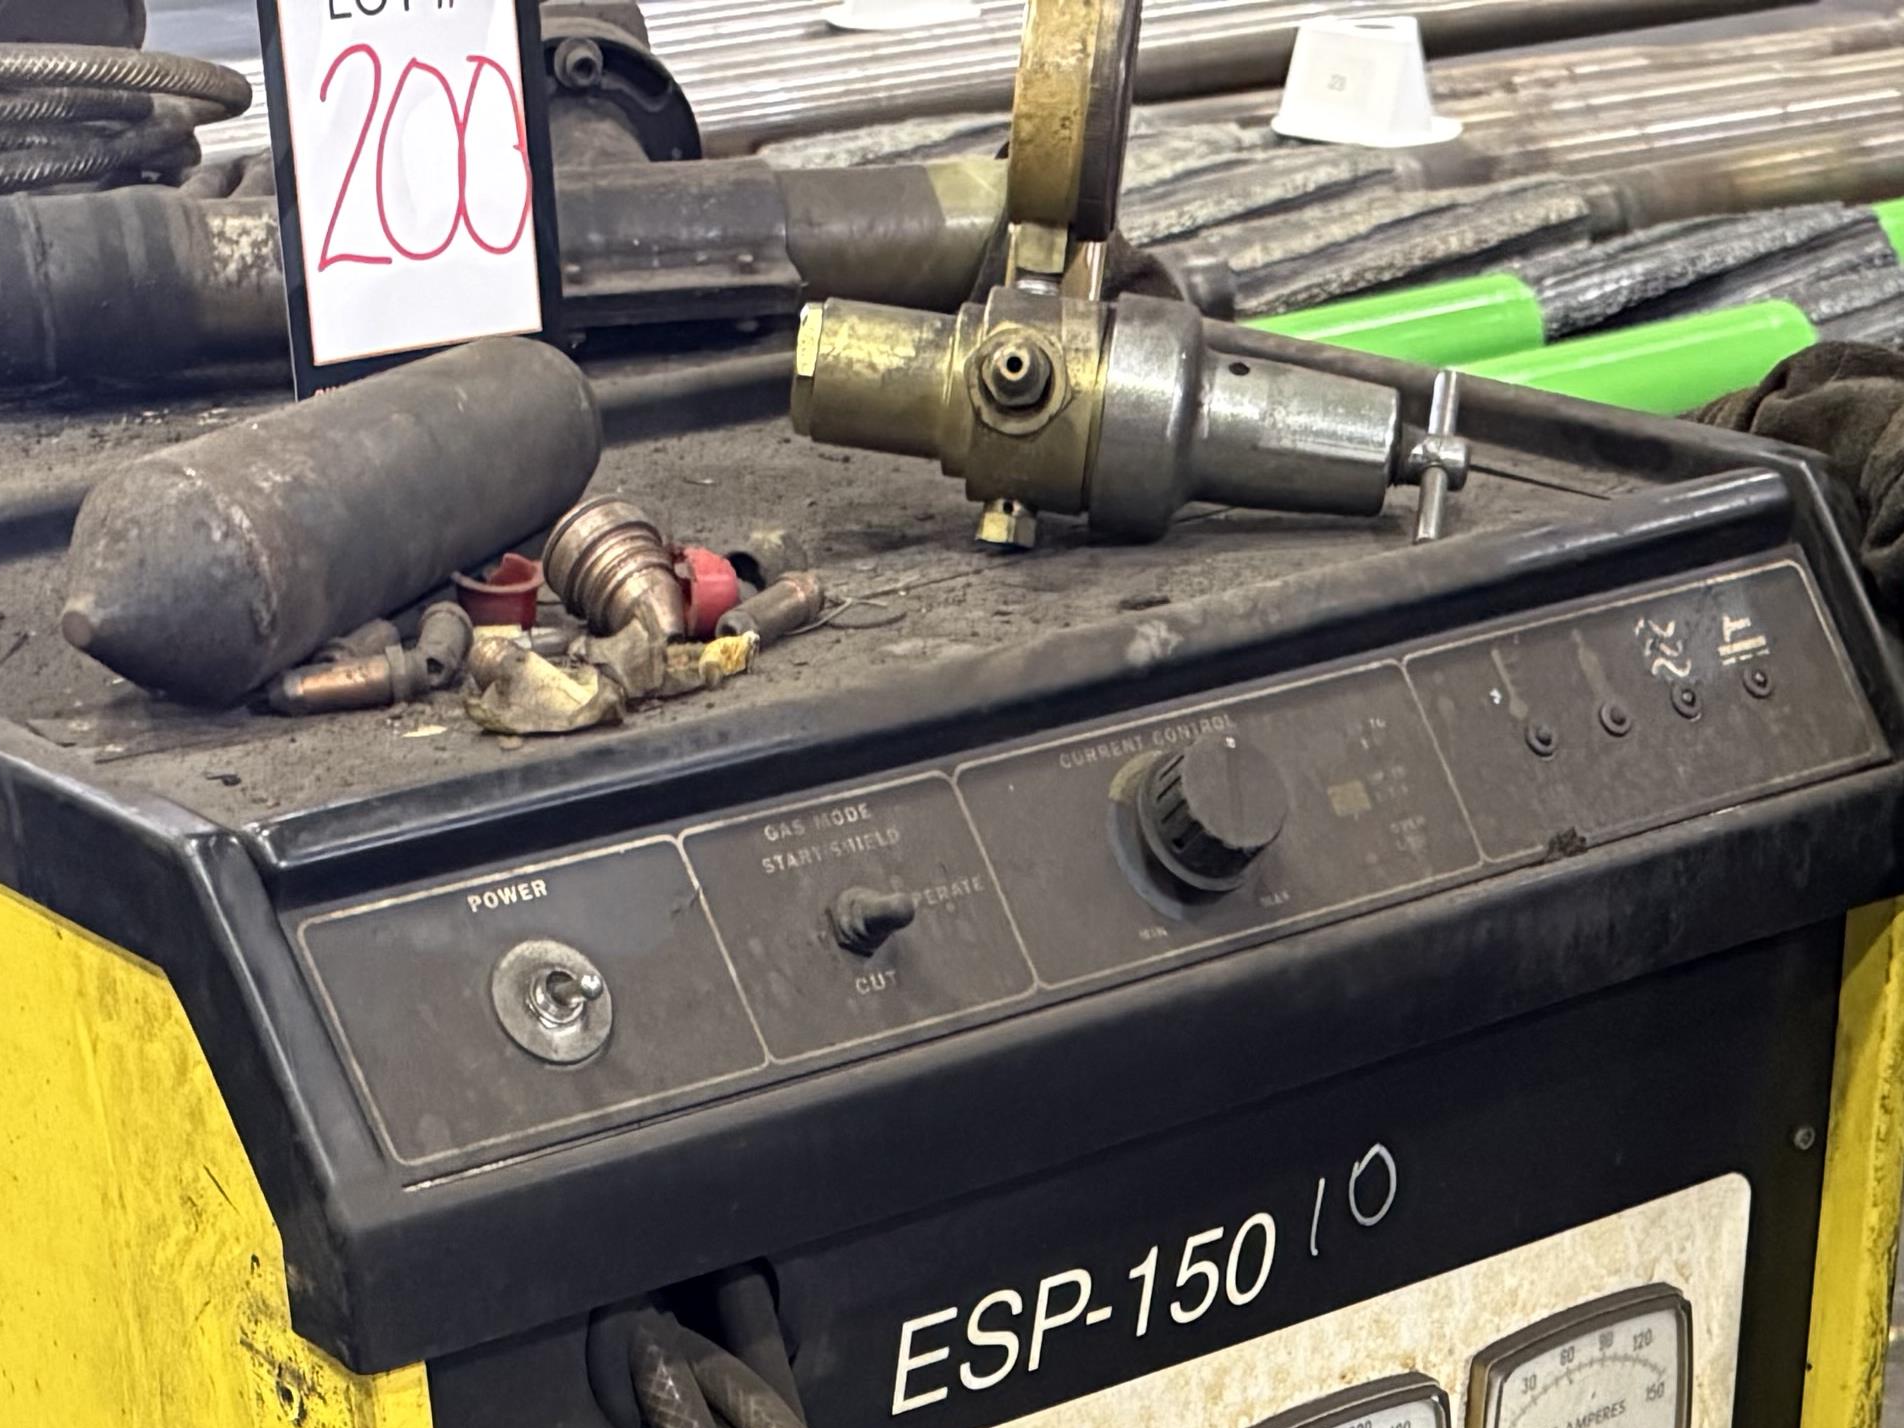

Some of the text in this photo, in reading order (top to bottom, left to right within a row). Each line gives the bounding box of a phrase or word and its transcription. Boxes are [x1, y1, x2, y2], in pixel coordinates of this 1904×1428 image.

[317, 43, 533, 272] 200
[1059, 713, 1237, 768] CURRENT CONTROL
[764, 802, 872, 841] GAS MODE
[762, 847, 823, 874] START
[467, 879, 548, 912] POWER
[912, 876, 984, 908] PERATE
[855, 970, 897, 995] CUT
[892, 1212, 1277, 1416] ESP-150
[1633, 1328, 1653, 1352] 120
[1521, 1373, 1538, 1395] 30
[1646, 1382, 1665, 1402] 150
